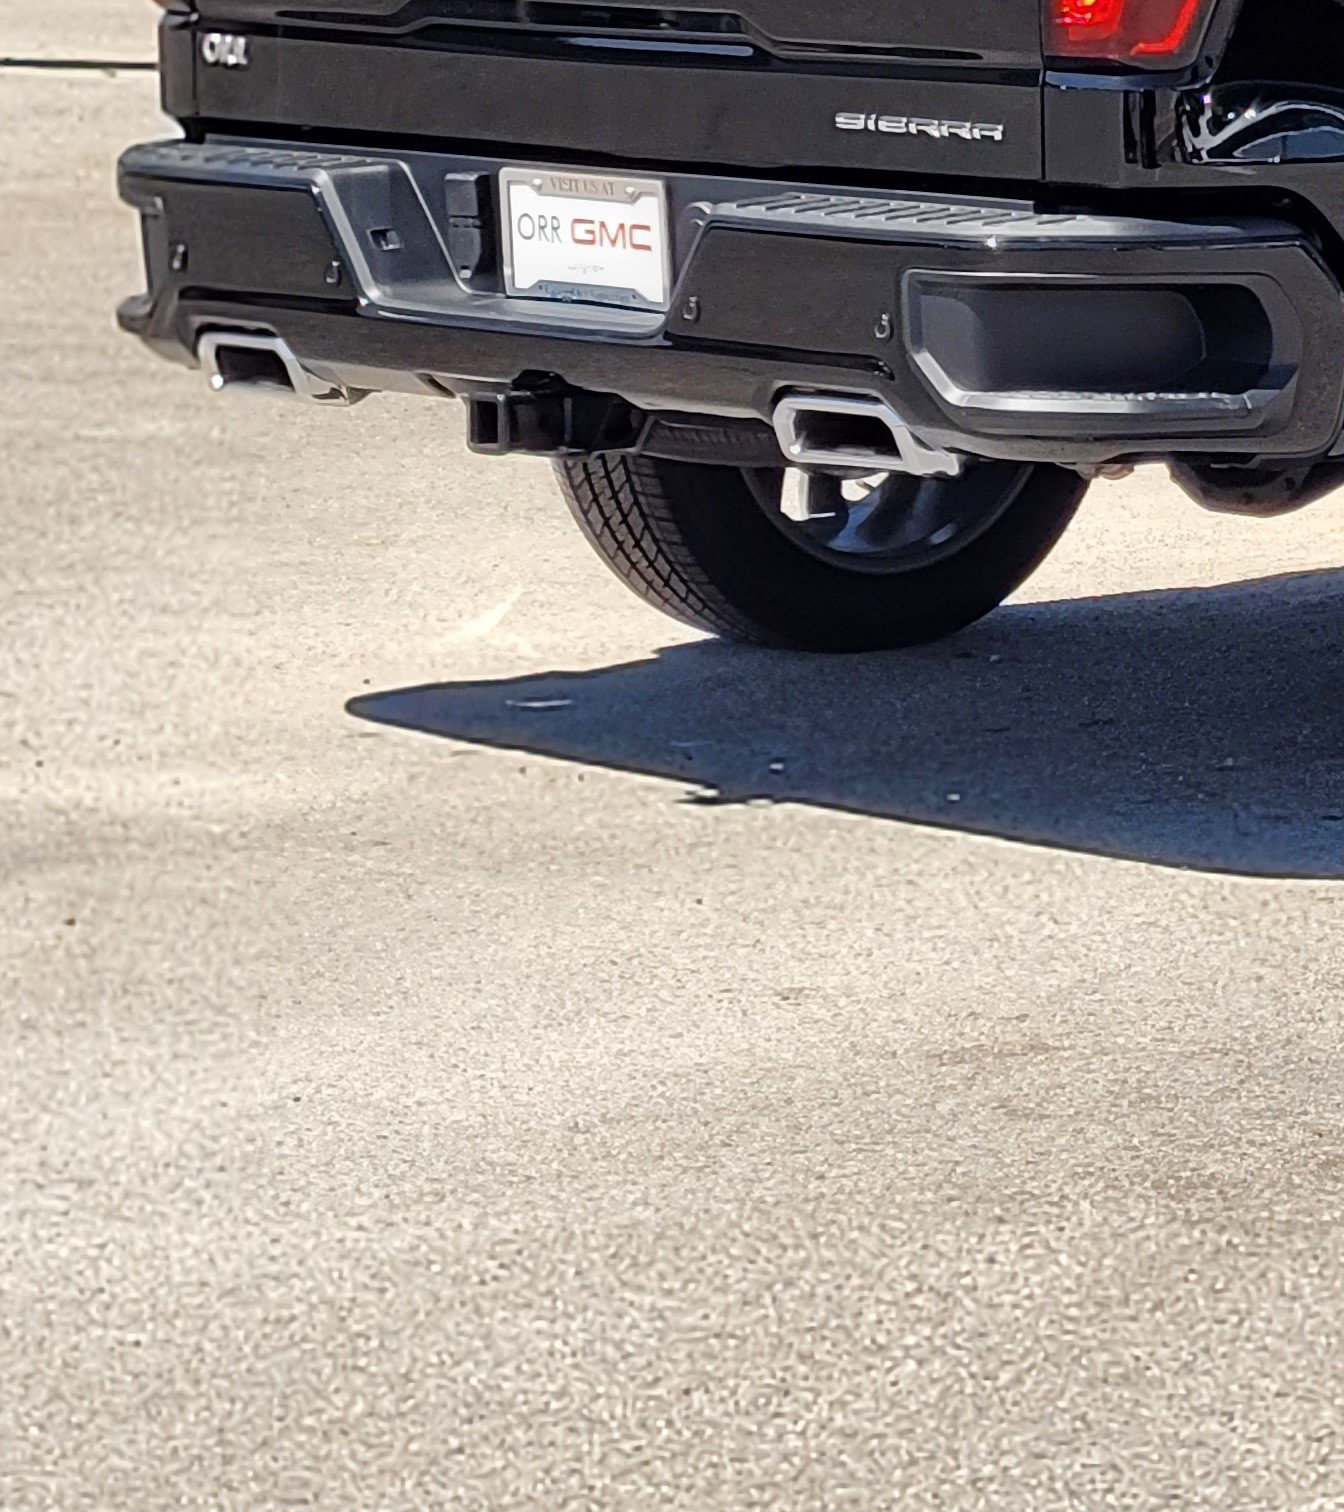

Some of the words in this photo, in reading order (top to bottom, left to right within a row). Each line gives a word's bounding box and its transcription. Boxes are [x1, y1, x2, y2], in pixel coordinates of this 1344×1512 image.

[834, 111, 1004, 141] SIERRA
[517, 212, 563, 244] ORR
[571, 218, 652, 252] GMC
